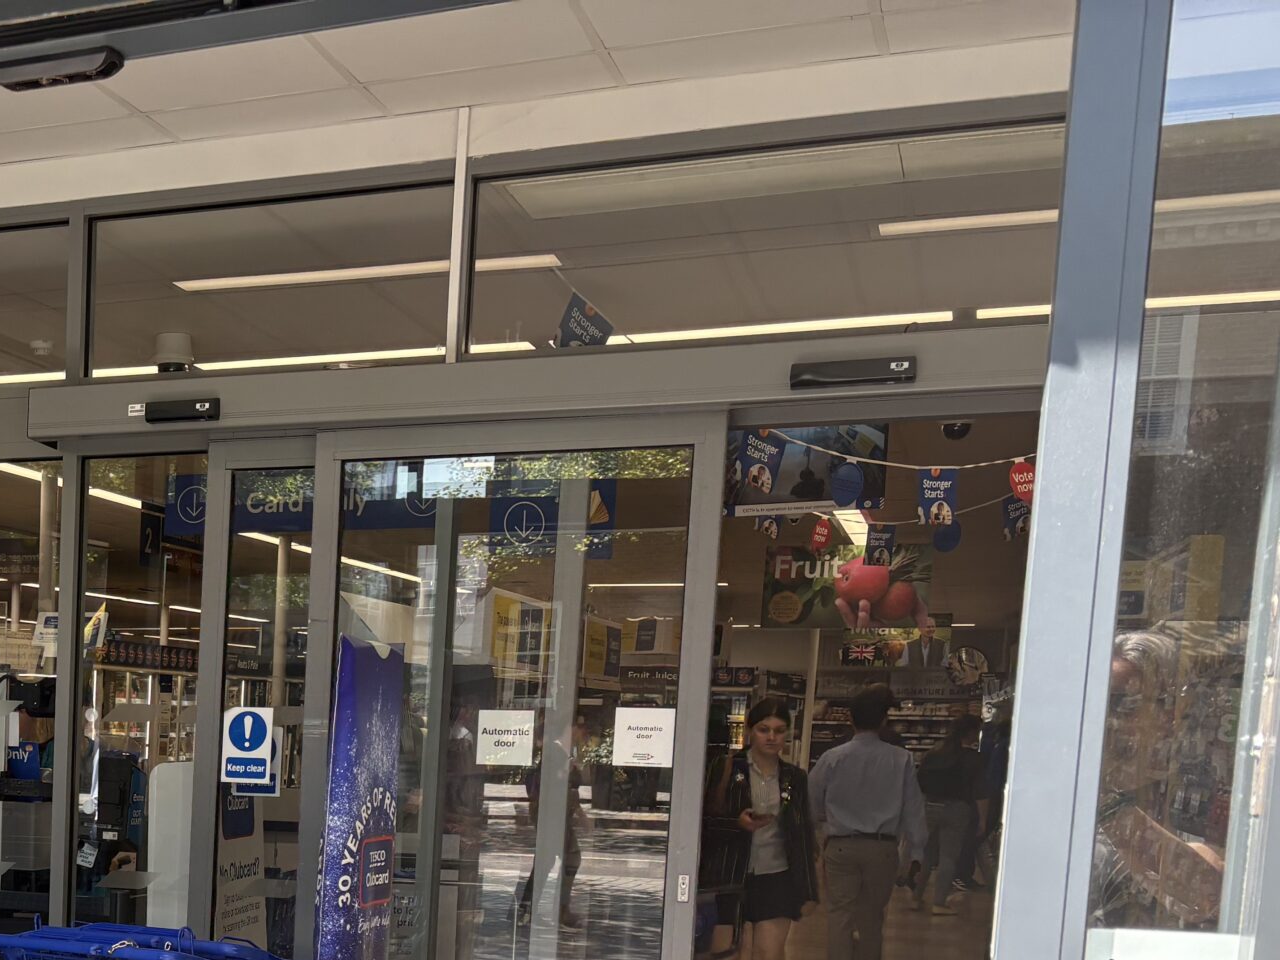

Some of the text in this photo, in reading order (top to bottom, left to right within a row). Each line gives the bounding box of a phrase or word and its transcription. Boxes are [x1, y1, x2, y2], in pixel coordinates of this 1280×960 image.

[569, 318, 590, 343] Starts
[572, 307, 603, 339] Stronger
[747, 434, 779, 456] Stronger
[746, 445, 768, 462] Starts
[922, 479, 952, 490] Stronger
[1013, 472, 1034, 483] Vote
[924, 489, 944, 498] Starts
[246, 492, 303, 514] Card
[814, 534, 826, 542] now
[815, 526, 828, 535] Vote
[145, 527, 153, 554] 2
[774, 554, 842, 580] Fruit
[628, 671, 649, 679] Fruit
[481, 727, 530, 736] Automatic
[627, 724, 663, 732] Automatic
[494, 739, 516, 748] door
[636, 732, 653, 740] door
[227, 763, 265, 773] Keep clear
[227, 796, 249, 811] Clubcard
[372, 786, 384, 807] OF
[341, 796, 372, 866] YEARS
[369, 850, 386, 862] TESCO
[229, 857, 260, 881] Clubcard?
[366, 869, 389, 887] Clubcard
[338, 875, 352, 908] 30
